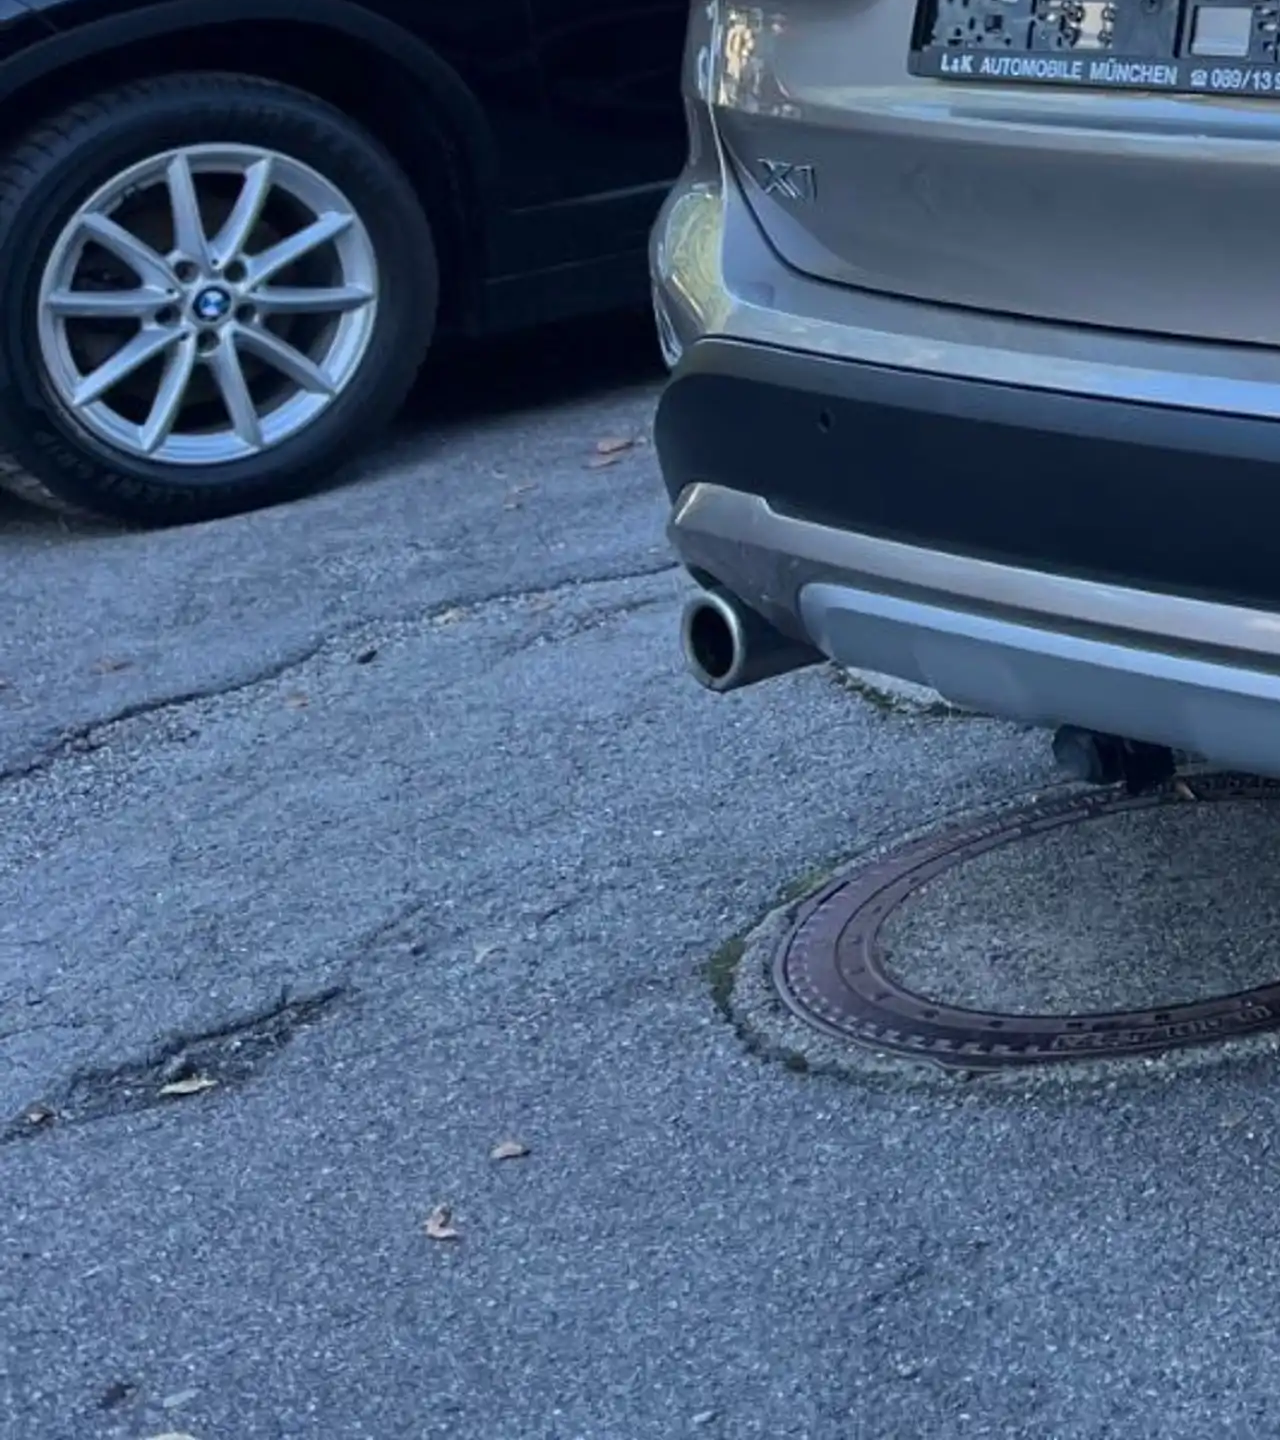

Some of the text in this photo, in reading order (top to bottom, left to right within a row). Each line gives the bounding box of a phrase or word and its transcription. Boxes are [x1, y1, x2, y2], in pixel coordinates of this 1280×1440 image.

[980, 57, 1082, 80] AUTOMOBILE
[1089, 58, 1178, 85] MÜNCHEN
[756, 157, 816, 202] X1
